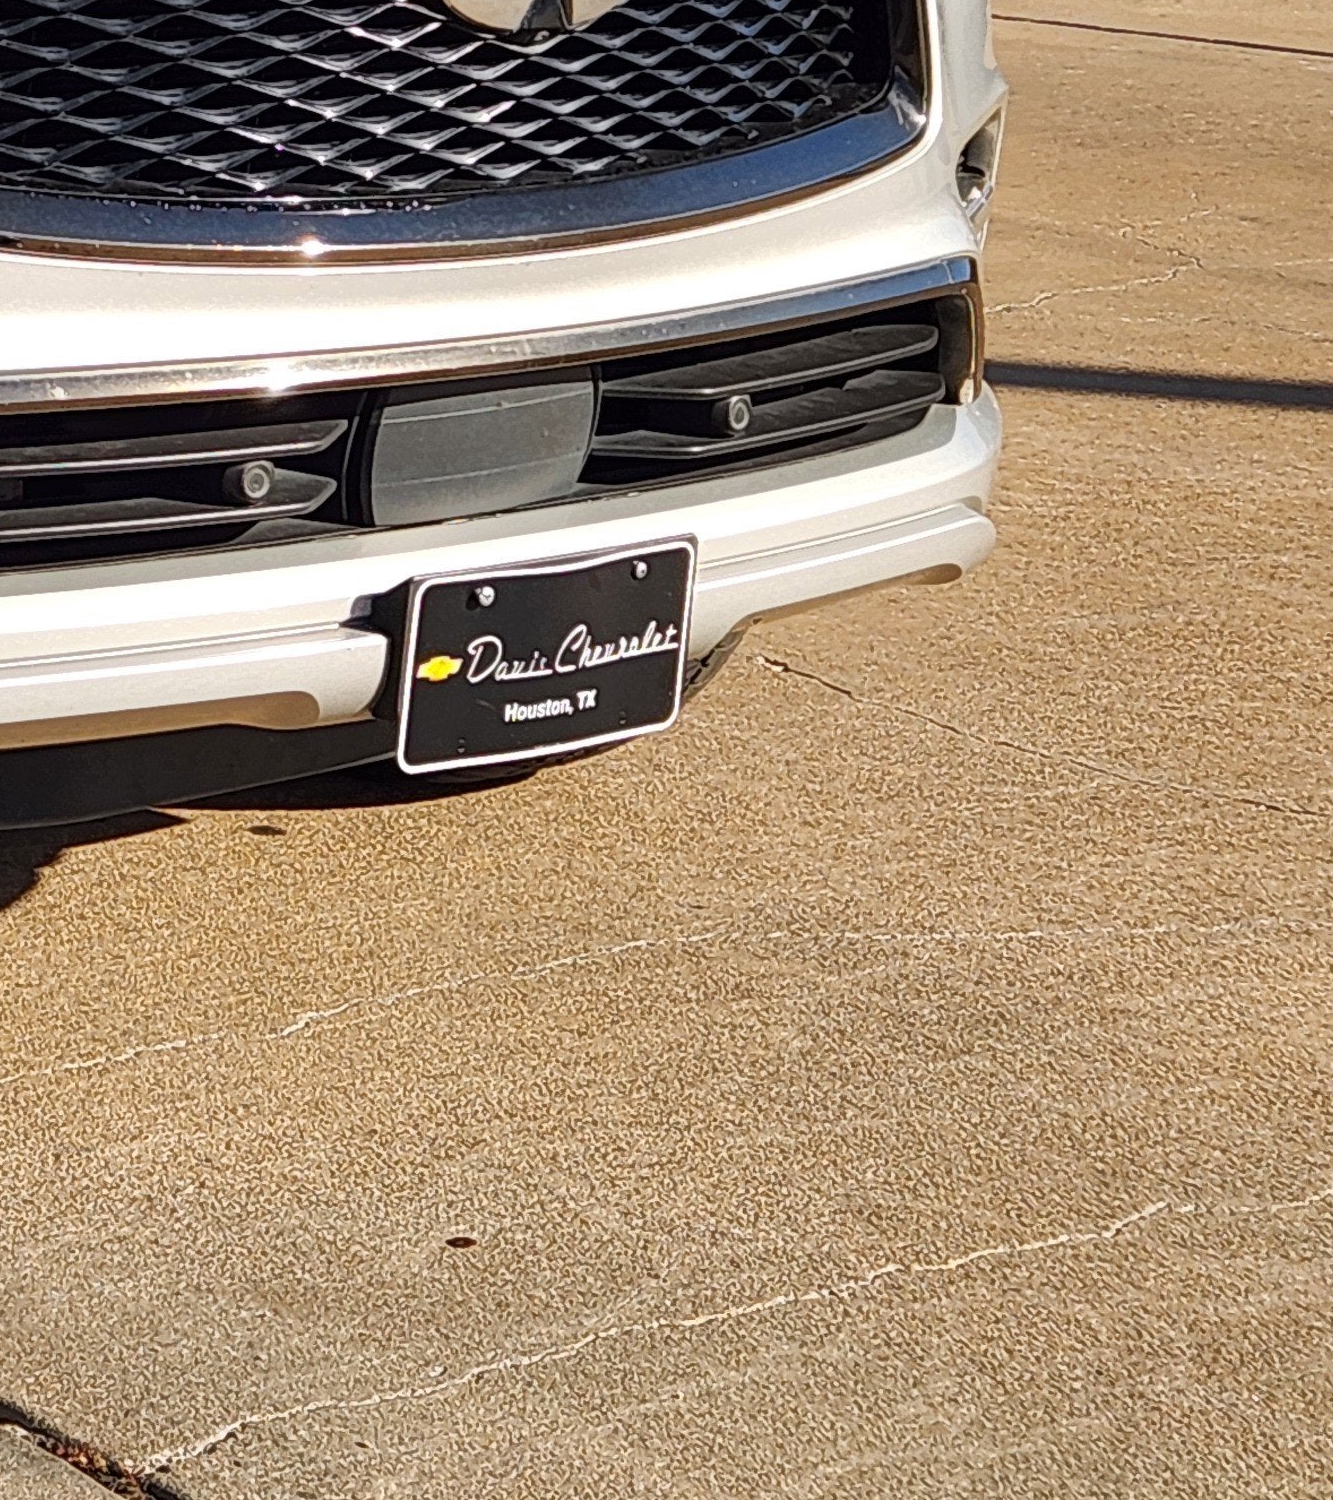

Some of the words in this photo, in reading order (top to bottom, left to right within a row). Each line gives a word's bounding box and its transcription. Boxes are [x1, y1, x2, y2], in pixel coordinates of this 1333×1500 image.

[466, 635, 553, 683] Davis
[555, 620, 678, 673] Chevrolet
[504, 698, 574, 723] Houston,
[576, 688, 597, 711] TX
